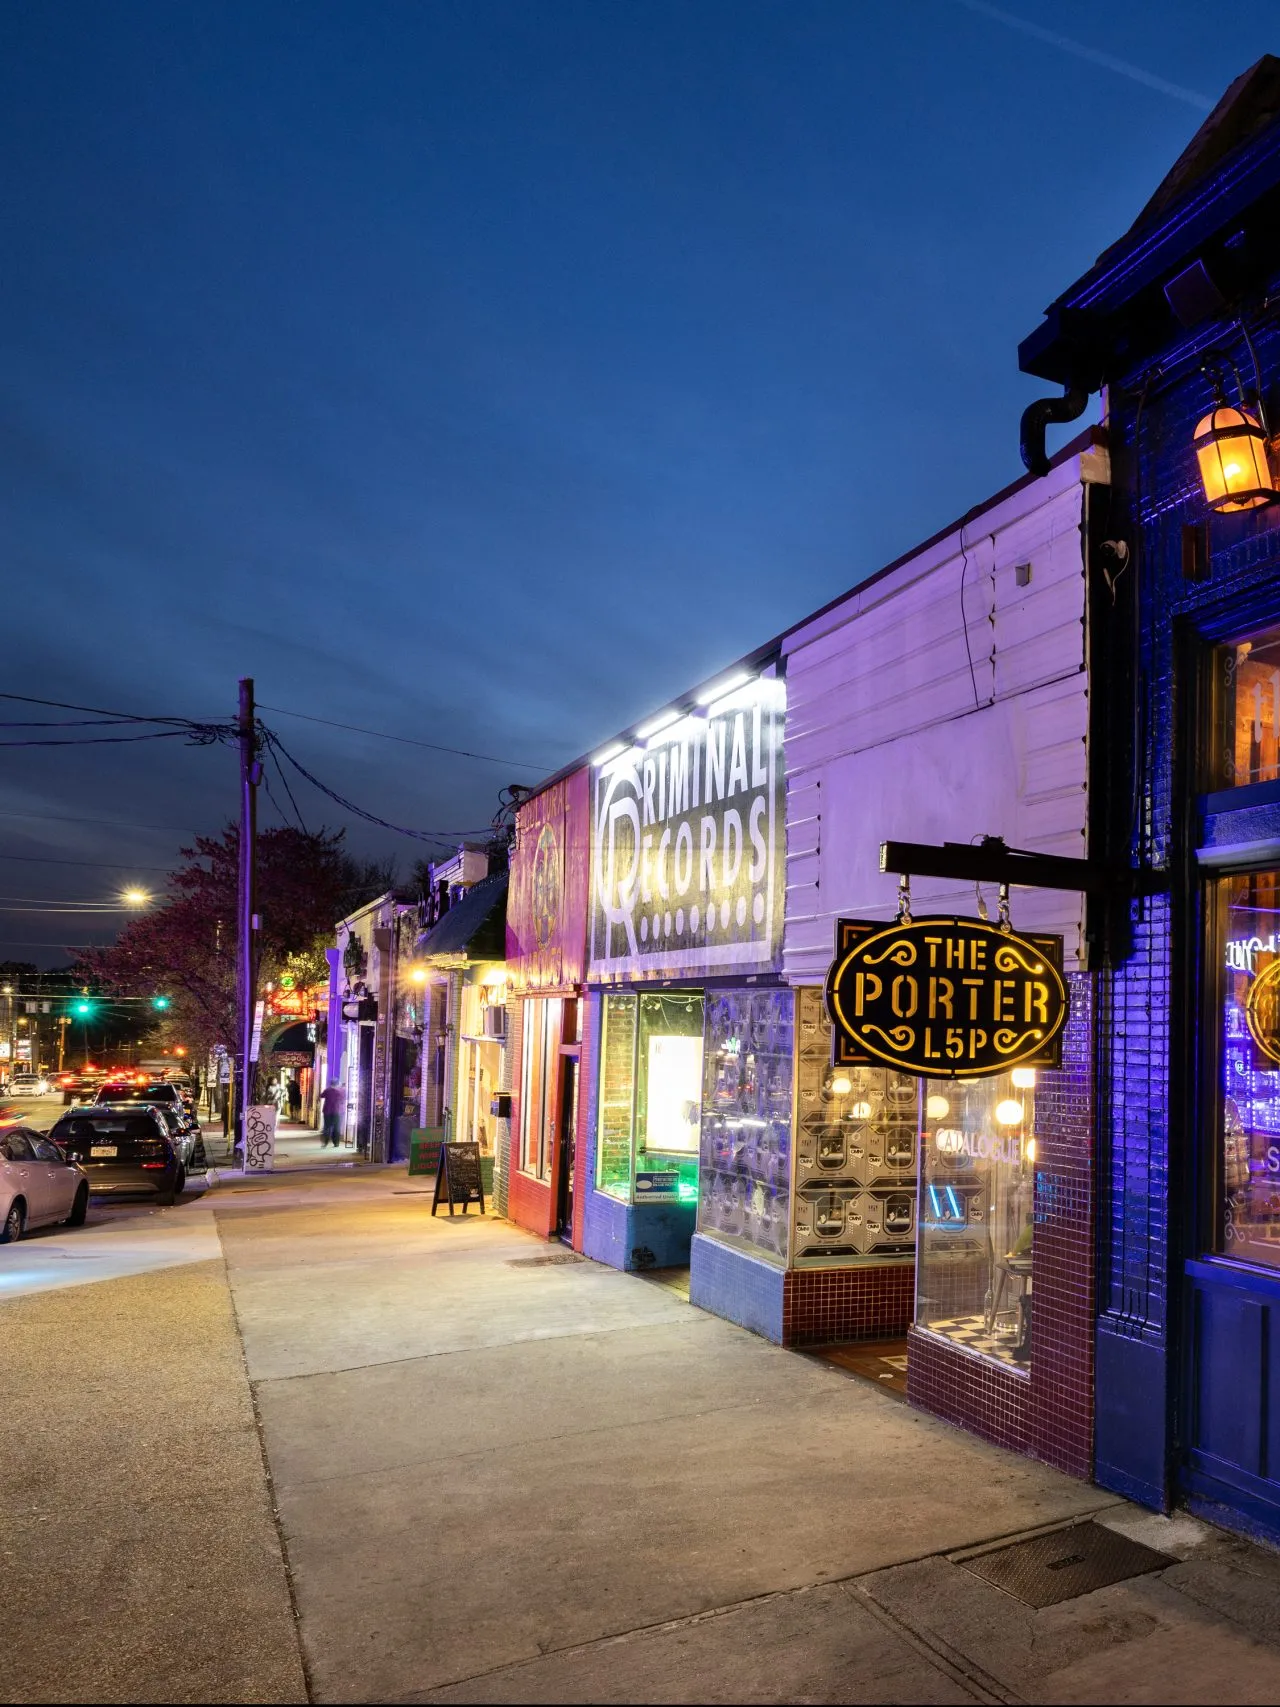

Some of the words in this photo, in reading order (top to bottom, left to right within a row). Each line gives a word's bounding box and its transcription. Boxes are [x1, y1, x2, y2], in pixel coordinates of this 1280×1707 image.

[924, 936, 987, 971] THE
[854, 972, 1049, 1023] PORTER
[924, 1027, 987, 1059] L5P
[935, 1127, 1020, 1165] CATALOGUE
